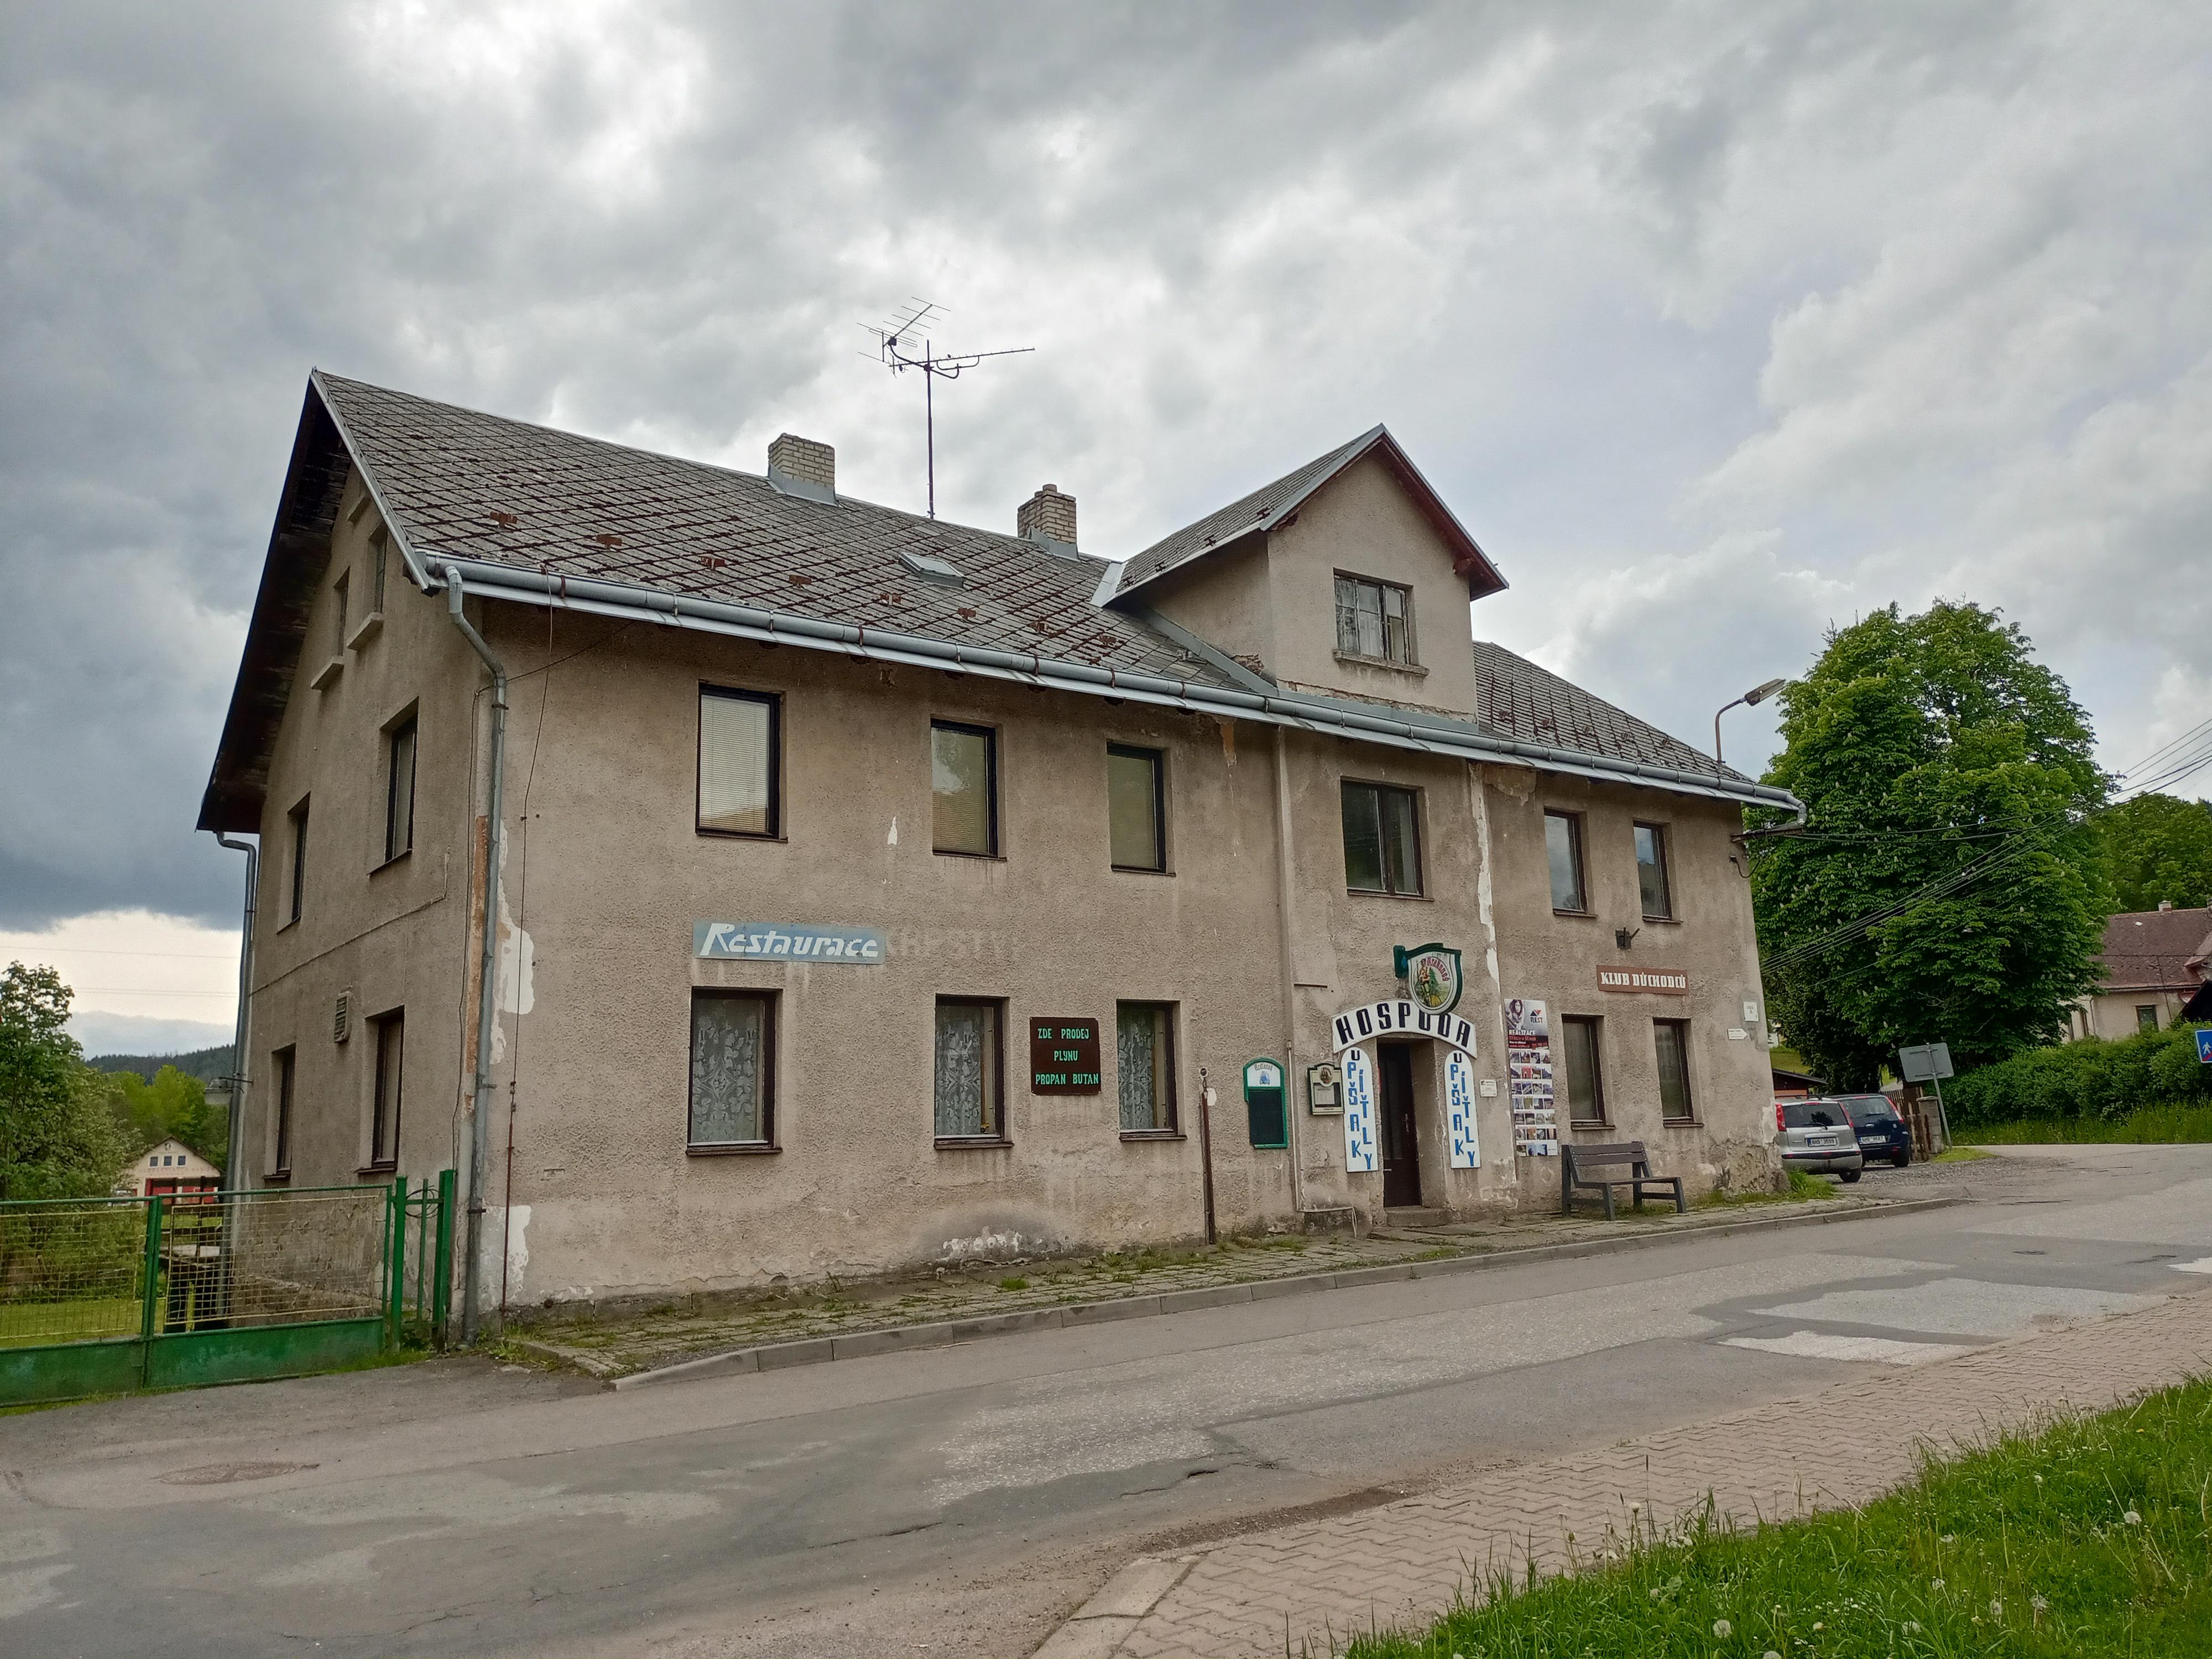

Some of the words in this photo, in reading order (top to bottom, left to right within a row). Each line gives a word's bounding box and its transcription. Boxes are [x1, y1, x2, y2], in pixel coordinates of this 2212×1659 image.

[699, 922, 879, 957] Restaurace
[1600, 972, 1630, 985] KLUB
[1632, 972, 1686, 989] DŮCHODCŮ
[1335, 1002, 1471, 1048] HOSPODA
[1037, 1028, 1052, 1039] ZDE
[1061, 1028, 1089, 1039] PRODEJ
[1053, 1050, 1078, 1061] PLYNU
[1351, 1050, 1360, 1061] U
[1453, 1053, 1462, 1063] U
[1035, 1073, 1066, 1084] PROPAN
[1072, 1073, 1098, 1084] BUTAN
